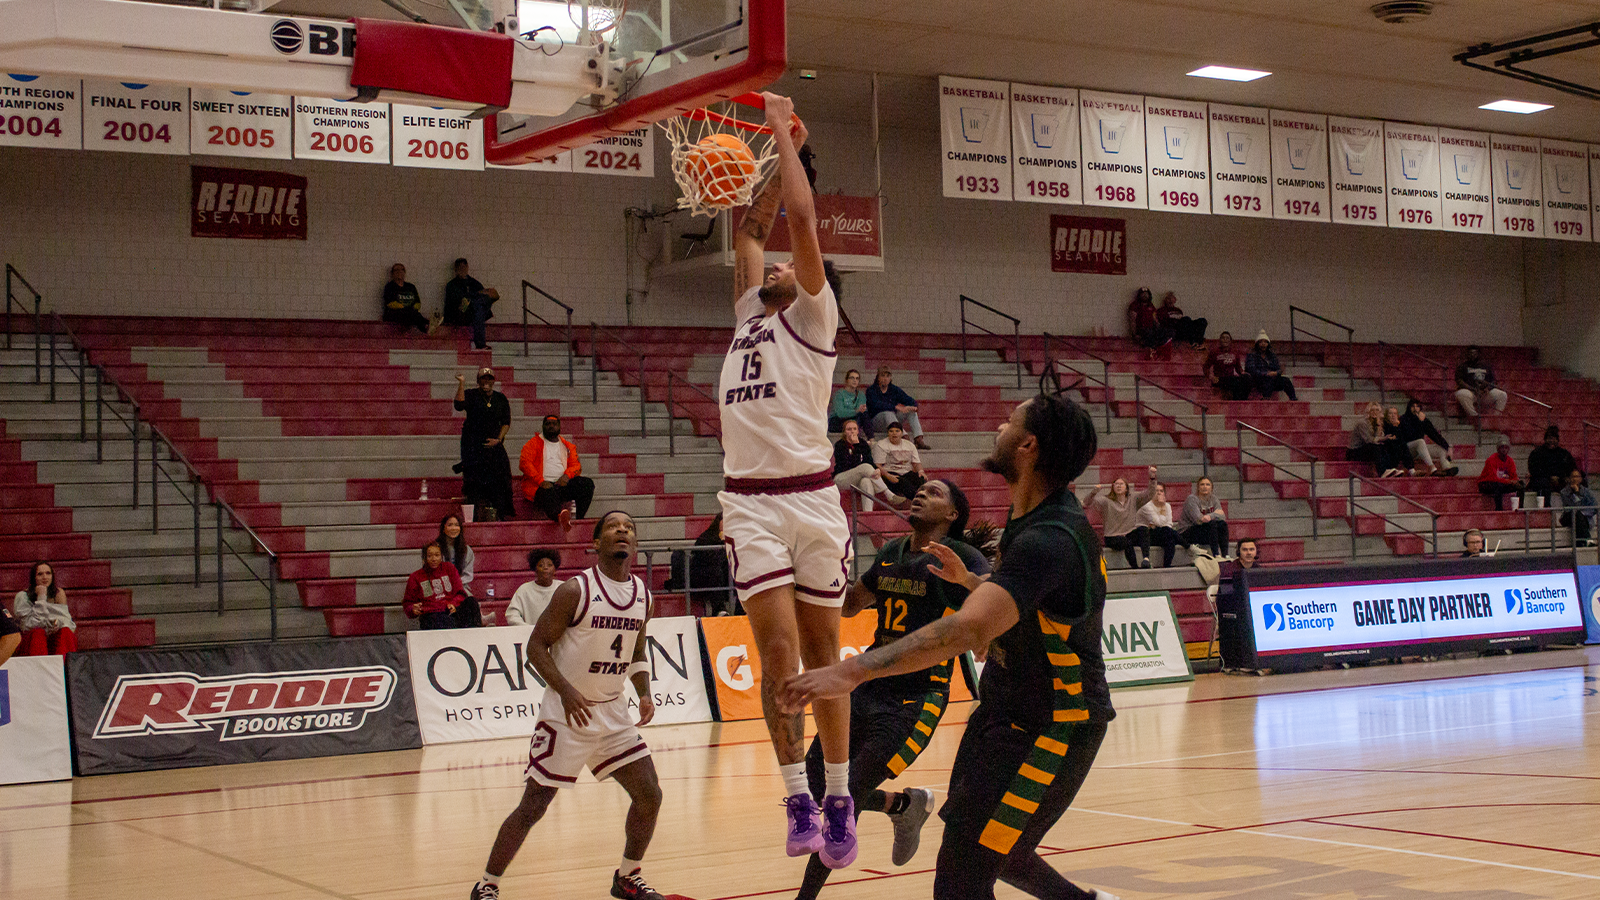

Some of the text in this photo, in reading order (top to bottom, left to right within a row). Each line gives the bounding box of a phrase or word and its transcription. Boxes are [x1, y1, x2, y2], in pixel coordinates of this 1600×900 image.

[25, 88, 74, 100] REGION
[943, 87, 1005, 100] BASKETBALL
[91, 96, 182, 112] FINAL FOUR
[193, 101, 289, 117] SWEET SIXTEEN
[297, 104, 386, 119] SOUTHERN REGION
[1149, 107, 1204, 120] BASKETBALL
[1212, 113, 1265, 126] BASKETBALL
[313, 118, 370, 129] CHAMPIONS
[403, 116, 472, 131] ELITE EIGHT
[103, 121, 172, 143] 2004
[208, 126, 275, 148] 2005
[1387, 131, 1436, 143] BASKETBALL
[310, 132, 374, 154] 2006
[408, 139, 469, 160] 2006
[1441, 136, 1487, 148] BASKETBALL
[1493, 142, 1538, 154] BASKETBALL
[585, 150, 642, 170] 2024
[947, 151, 1007, 164] CHAMPIONS
[1543, 148, 1586, 159] BASKETBALL
[1019, 157, 1077, 169] CHAMPIONS
[1088, 162, 1143, 174] CHAMPIONS
[1152, 167, 1206, 180] CHAMPIONS
[1216, 172, 1267, 184] CHAMPIONS
[956, 175, 999, 194] 1933
[1027, 180, 1069, 198] 1958
[1277, 178, 1325, 189] CHAMPIONS
[1336, 183, 1383, 194] CHAMPIONS
[197, 181, 303, 215] REDDIE
[1095, 185, 1135, 202] 1968
[1160, 190, 1199, 207] 1969
[1391, 187, 1438, 198] CHAMPIONS
[1445, 192, 1489, 203] CHAMPIONS
[1224, 195, 1261, 212] 1973
[1284, 200, 1320, 216] 1974
[1497, 197, 1540, 207] CHAMPIONS
[1548, 201, 1588, 211] CHAMPIONS
[198, 210, 300, 226] SEATING
[1342, 204, 1377, 220] 1975
[1399, 208, 1433, 224] 1976
[832, 212, 873, 235] YOURS
[1452, 213, 1483, 228] 1977
[1504, 217, 1534, 232] 1978
[1554, 221, 1583, 235] 1979
[1055, 227, 1122, 253] REDDIE
[1055, 251, 1122, 263] SEATING
[741, 351, 762, 381] 15
[725, 382, 776, 405] STATE
[1524, 587, 1567, 601] Southern
[884, 597, 908, 632] 12
[1286, 601, 1337, 615] Southern
[1353, 592, 1493, 627] GAME DAY PARTNER
[1526, 601, 1566, 615] Bancorp
[1288, 616, 1335, 631] Bancorp
[610, 634, 623, 659] 4
[588, 661, 630, 675] STATE
[716, 644, 754, 691] G
[1123, 660, 1165, 670] CORPORATION
[105, 672, 385, 731] REDDIE
[446, 707, 484, 722] HOT
[233, 711, 353, 734] BOOKSTORE
